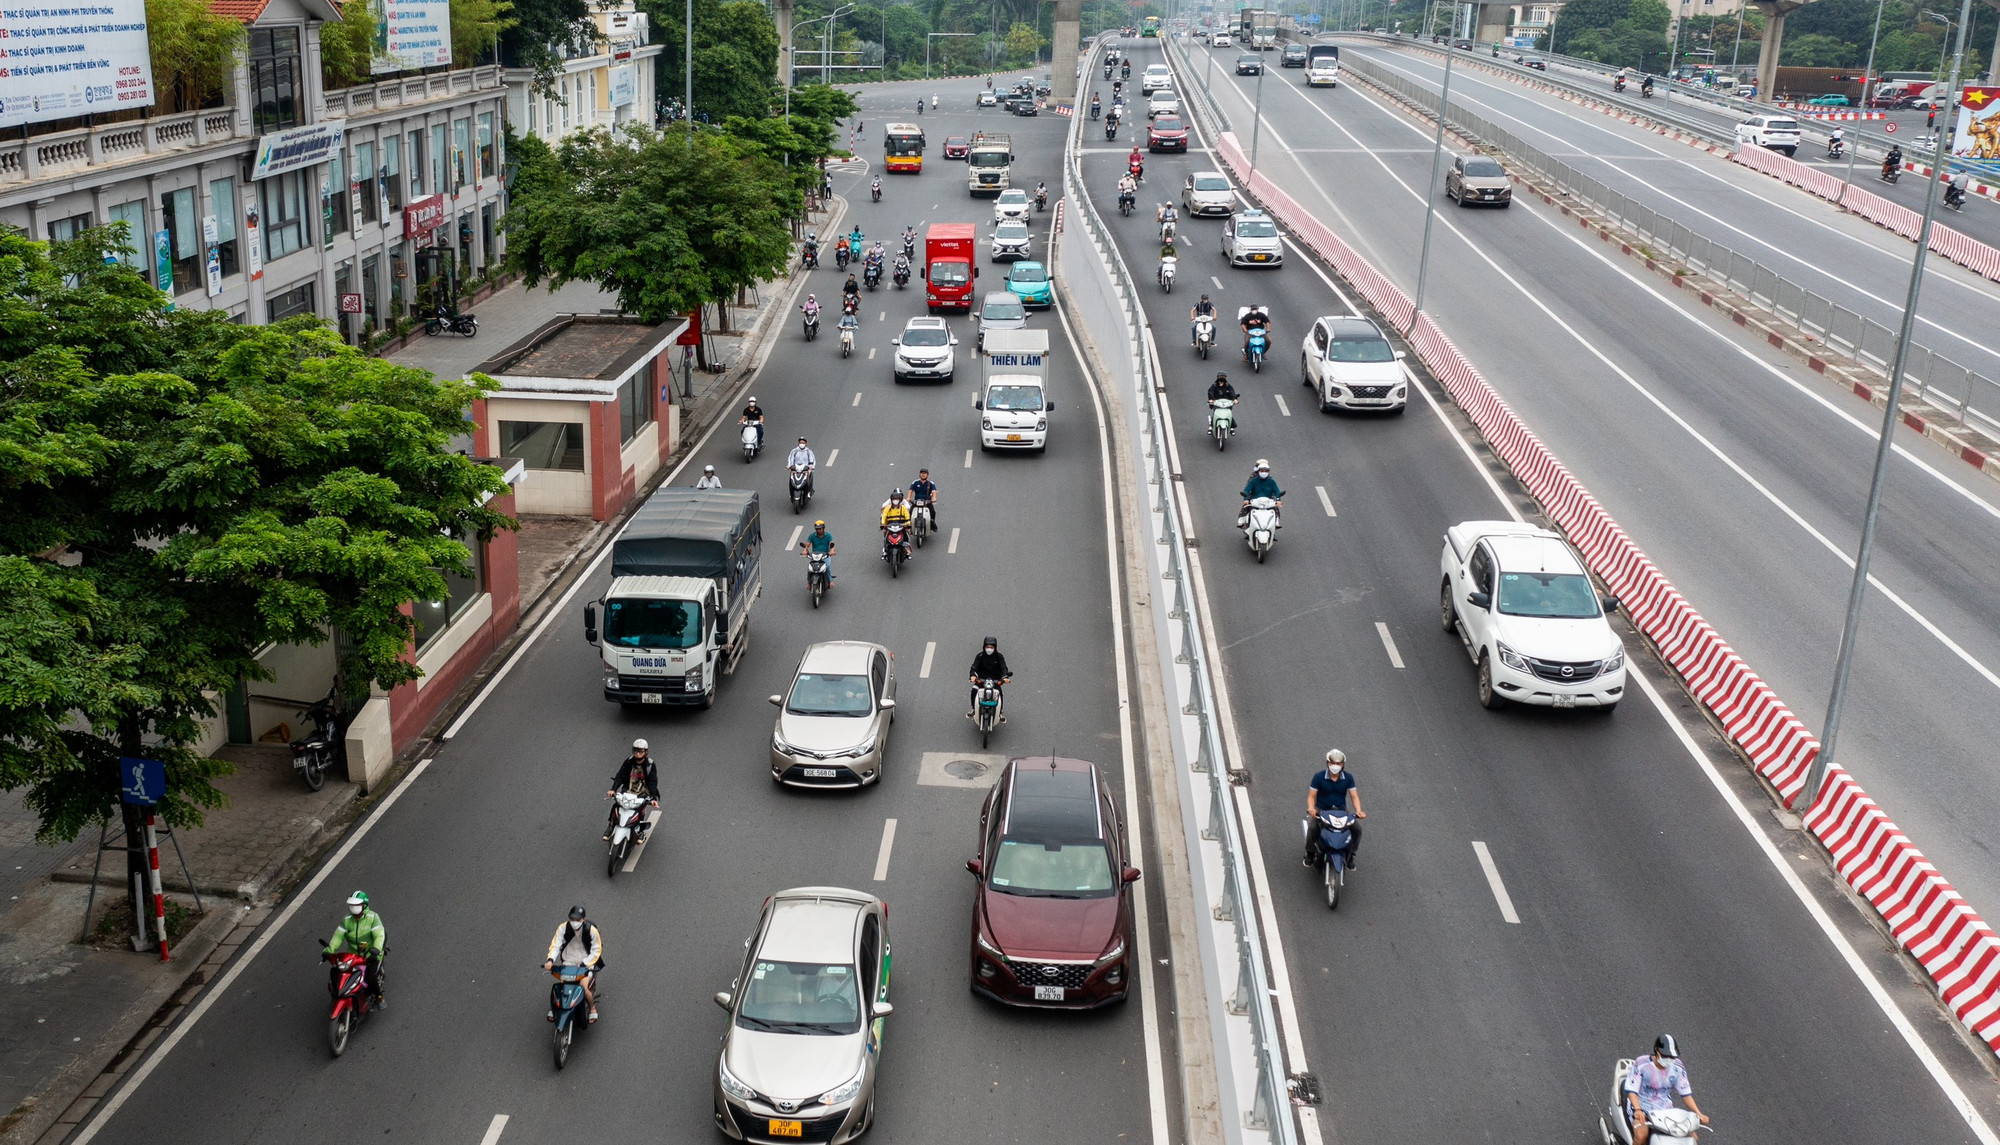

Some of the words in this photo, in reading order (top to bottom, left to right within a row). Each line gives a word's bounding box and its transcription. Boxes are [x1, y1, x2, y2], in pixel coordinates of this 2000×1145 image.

[3, 10, 18, 20] THẠC
[25, 6, 40, 19] QUẢN
[41, 9, 49, 19] TRỊ
[58, 8, 70, 16] NINH
[10, 29, 24, 39] THẠC
[32, 25, 46, 38] QUẢN
[47, 28, 56, 37] TRỊ
[56, 25, 70, 35] CÔNG
[114, 24, 130, 32] DOANH
[8, 49, 23, 59] THẠC
[30, 44, 45, 57] QUẢN
[45, 46, 54, 56] TRỊ
[67, 44, 85, 53] DOANH
[10, 65, 23, 77] TIẾN
[30, 63, 45, 76] QUẢN
[45, 65, 54, 75] TRỊ
[59, 61, 71, 72] PHÁT
[119, 66, 141, 76] HOTLINE:
[115, 80, 128, 89] 0968
[128, 78, 137, 87] 202
[137, 77, 147, 86] 244
[118, 92, 130, 101] 0903
[991, 354, 1018, 366] THIÊN
[1021, 354, 1041, 366] LÂM
[632, 657, 653, 668] QUANG
[778, 1120, 793, 1128] 30F
